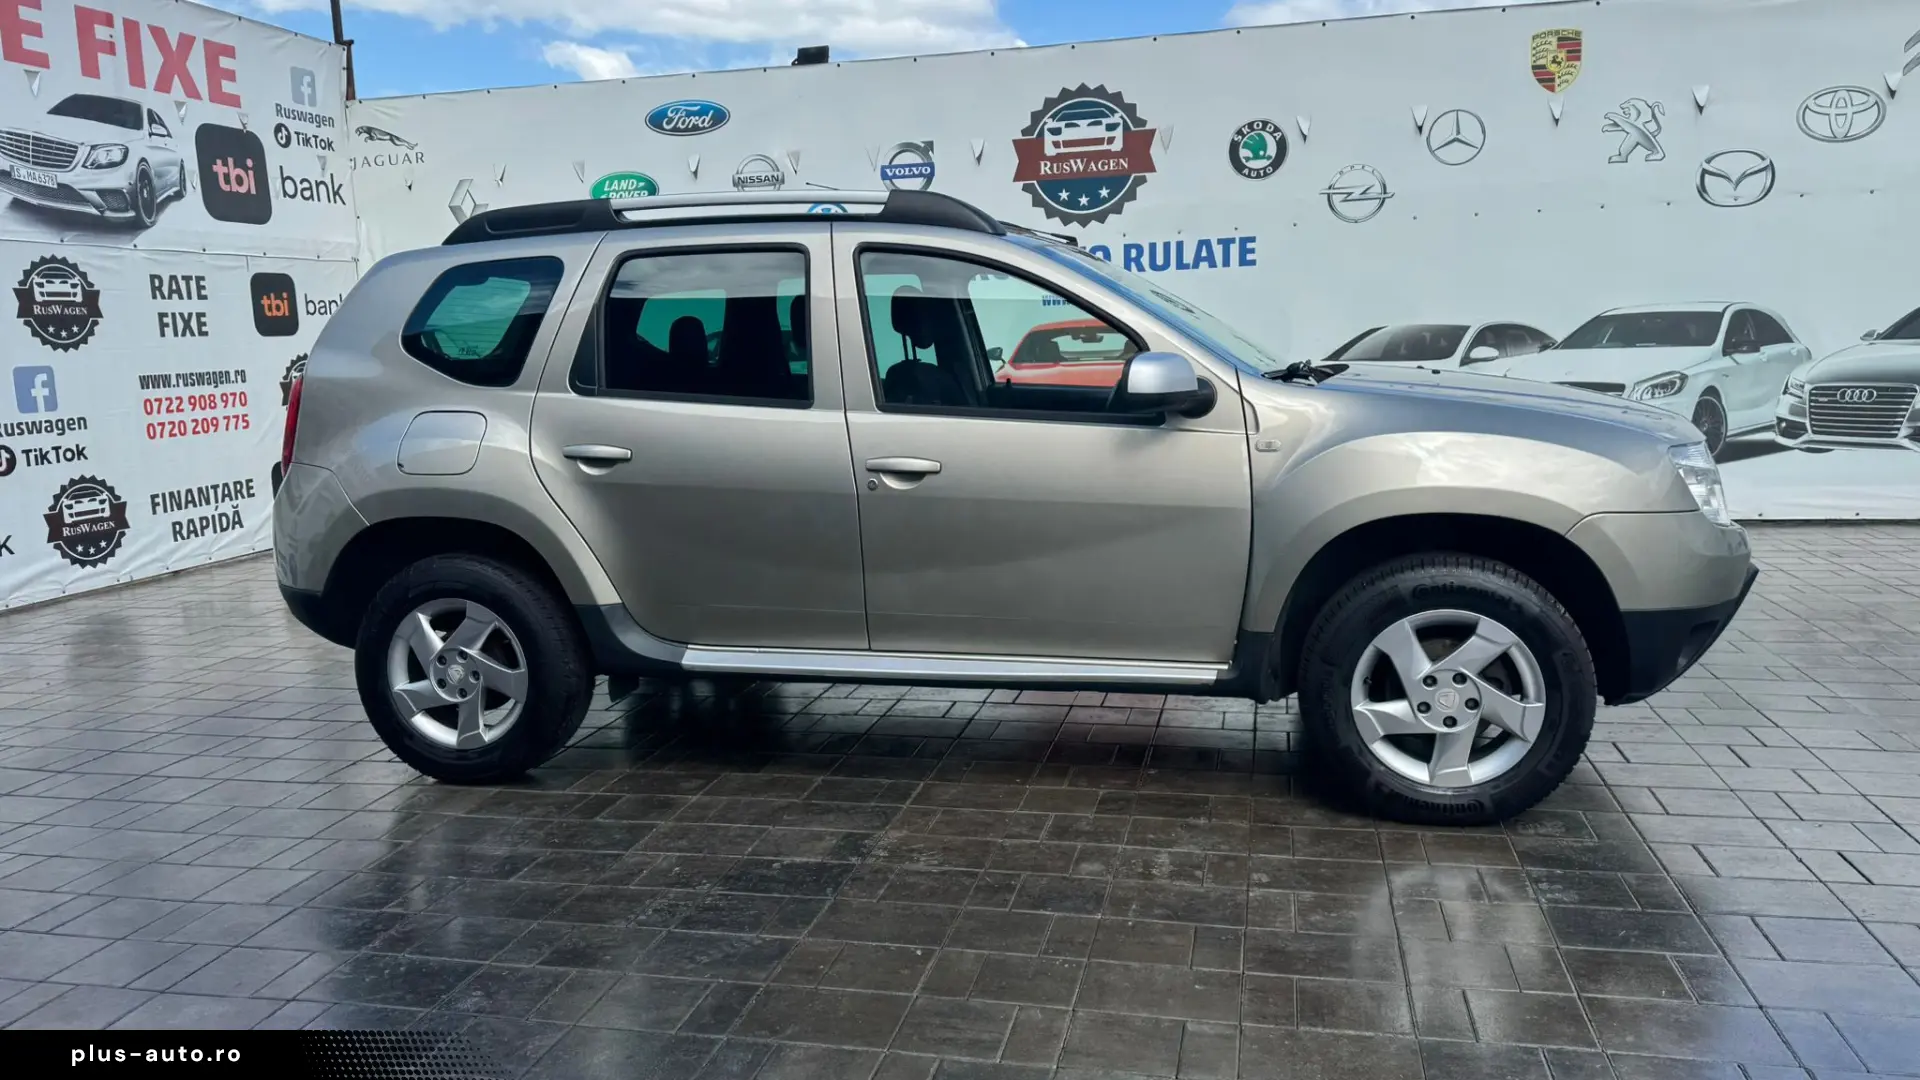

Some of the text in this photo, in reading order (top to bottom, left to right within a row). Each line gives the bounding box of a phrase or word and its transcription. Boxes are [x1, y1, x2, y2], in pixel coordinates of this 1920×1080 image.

[74, 4, 242, 109] FIXE
[275, 102, 335, 129] Ruswagen
[663, 105, 714, 130] Ford
[294, 131, 336, 152] TikTok
[1234, 121, 1282, 142] SKODA
[351, 152, 425, 171] JAGUAR
[884, 165, 931, 177] VOLVO
[1242, 166, 1273, 178] AUTO
[212, 157, 346, 205] tbi bank
[604, 180, 637, 192] LAND
[736, 174, 780, 185] NISSAN
[1123, 236, 1257, 273] RULATE
[149, 274, 208, 300] RATE
[261, 292, 289, 316] tbi
[157, 312, 209, 338] FIXE
[138, 369, 247, 390] www.ruswagen.ro
[143, 391, 248, 416] 0722 908 970
[146, 414, 250, 440] 0720 209 775
[21, 443, 89, 467] TikTok
[171, 503, 245, 543] RAPIDĂ
